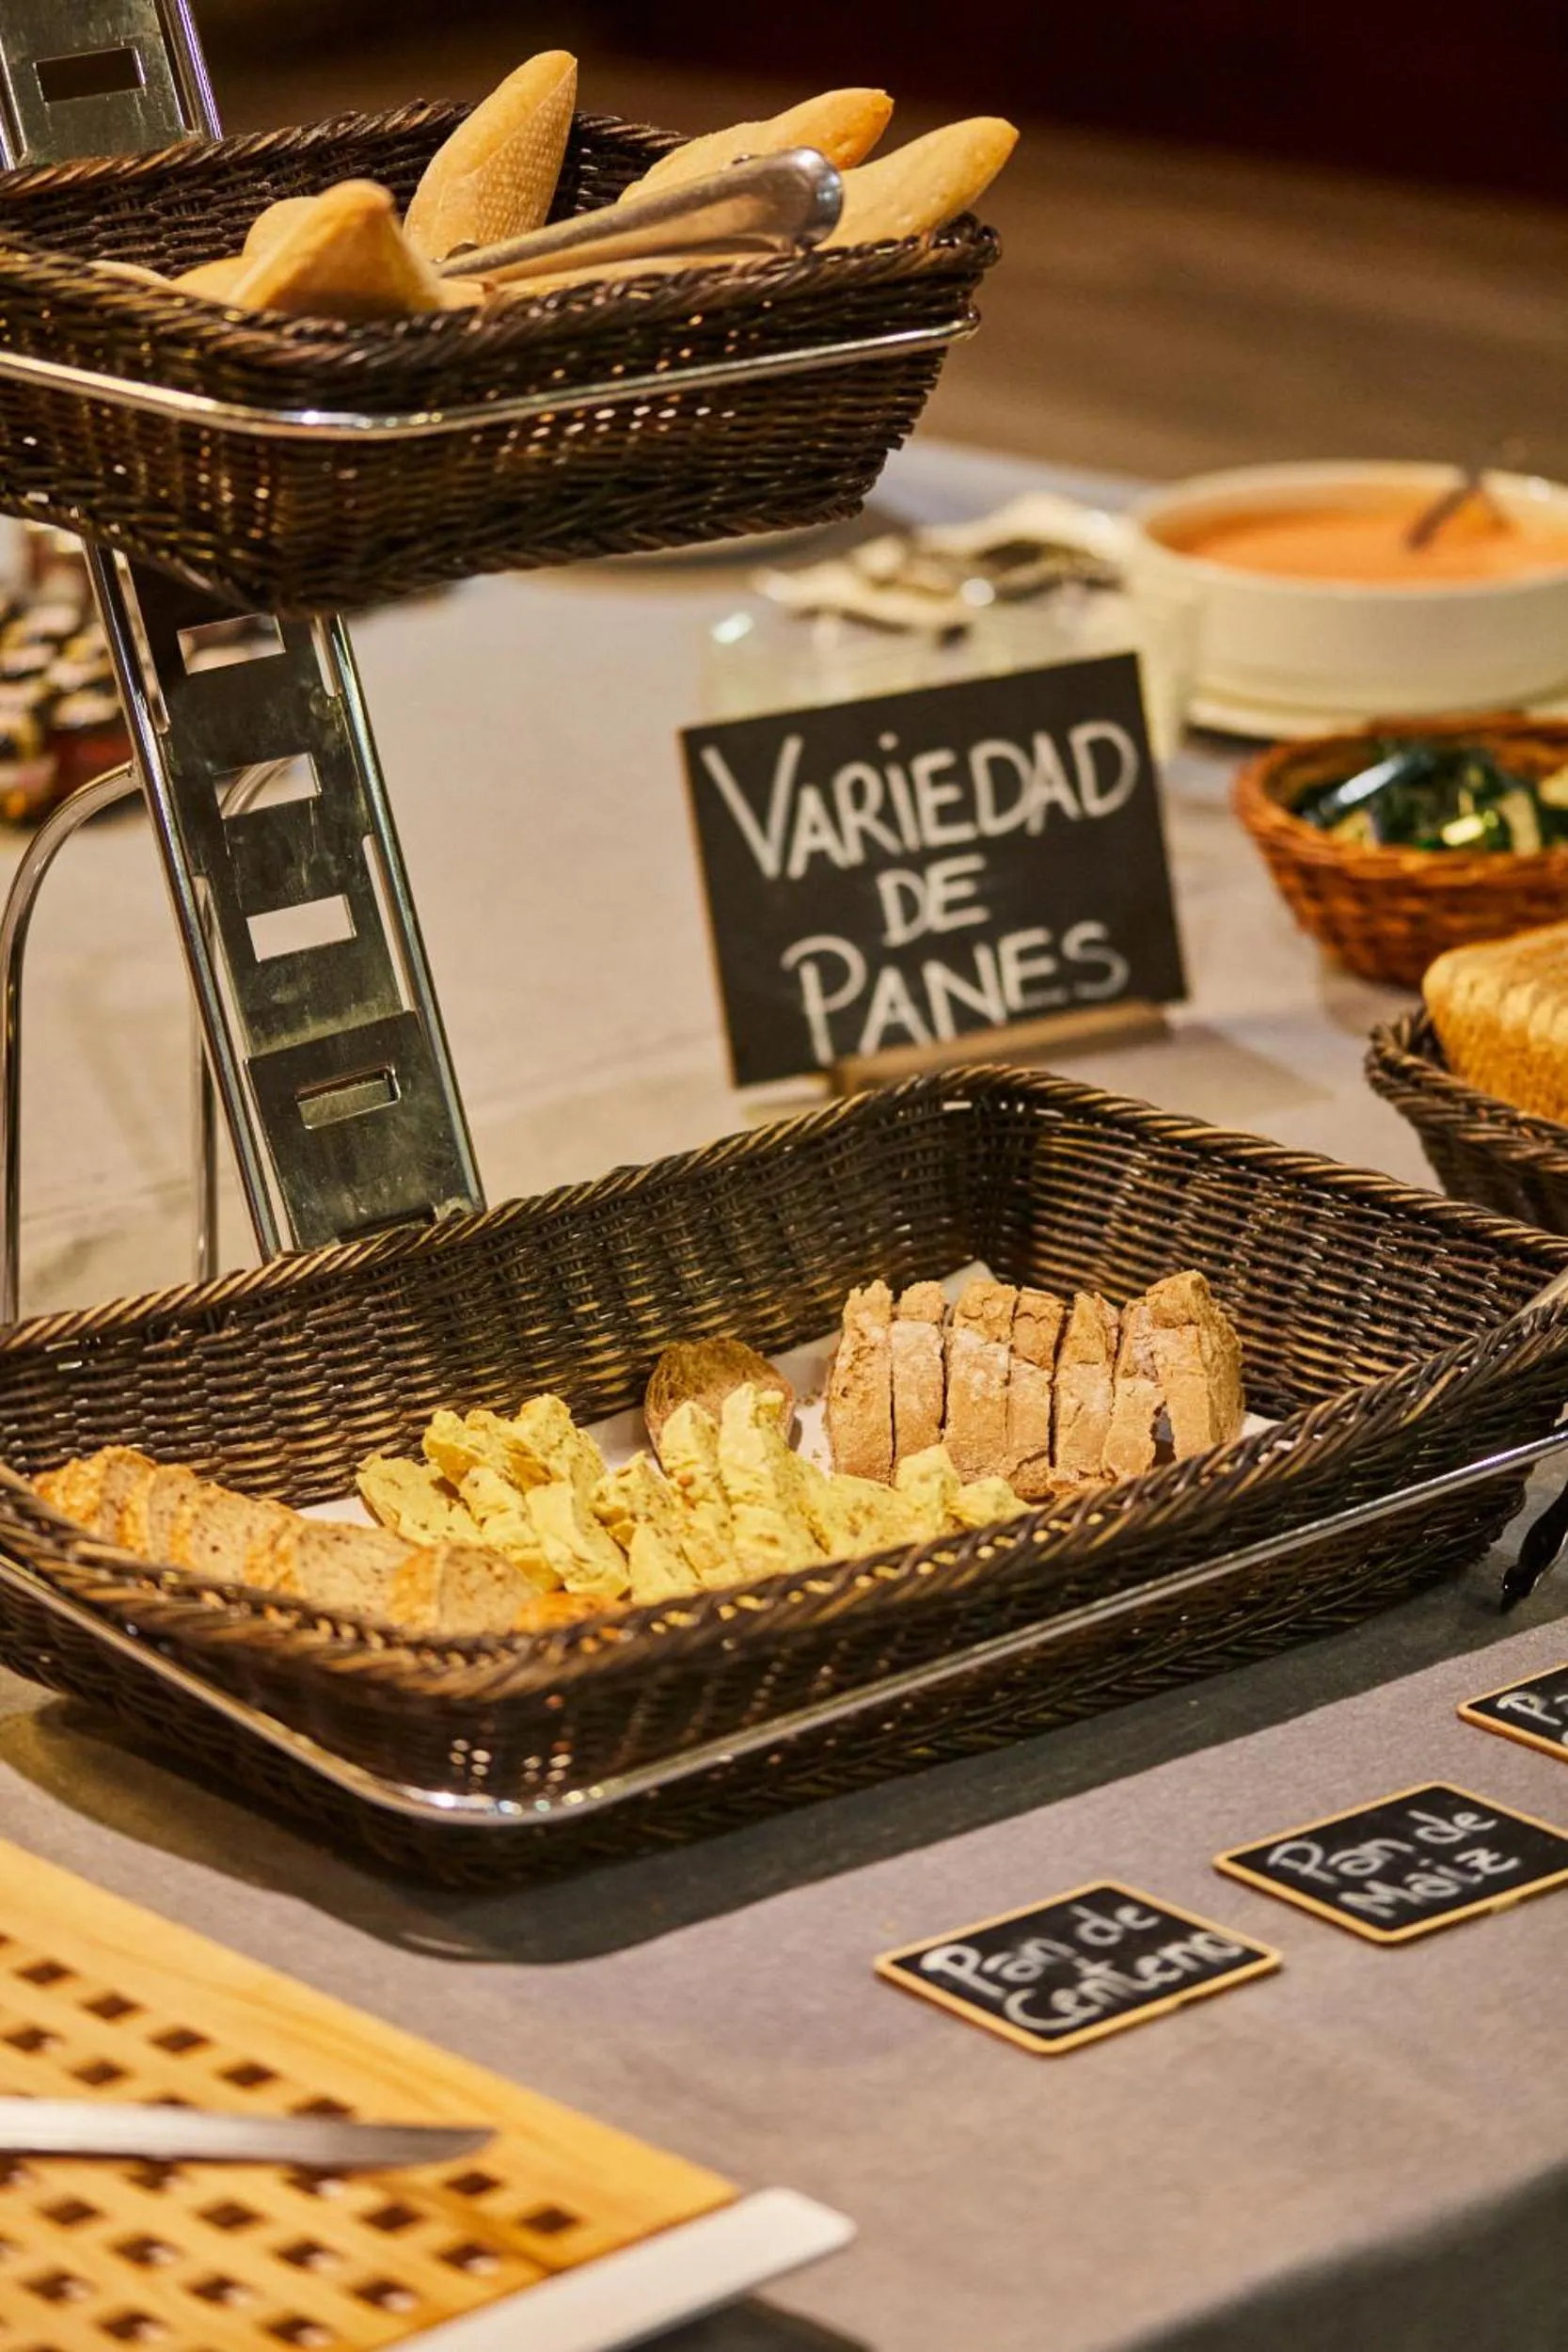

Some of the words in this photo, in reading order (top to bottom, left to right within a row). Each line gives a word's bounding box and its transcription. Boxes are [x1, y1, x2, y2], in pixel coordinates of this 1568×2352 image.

[876, 852, 989, 946] DE
[781, 921, 1130, 1065] PANES
[1268, 1838, 1415, 1884] Pan
[1407, 1810, 1498, 1844] de
[920, 1943, 1079, 1998] Pan
[1070, 1904, 1160, 1947] de
